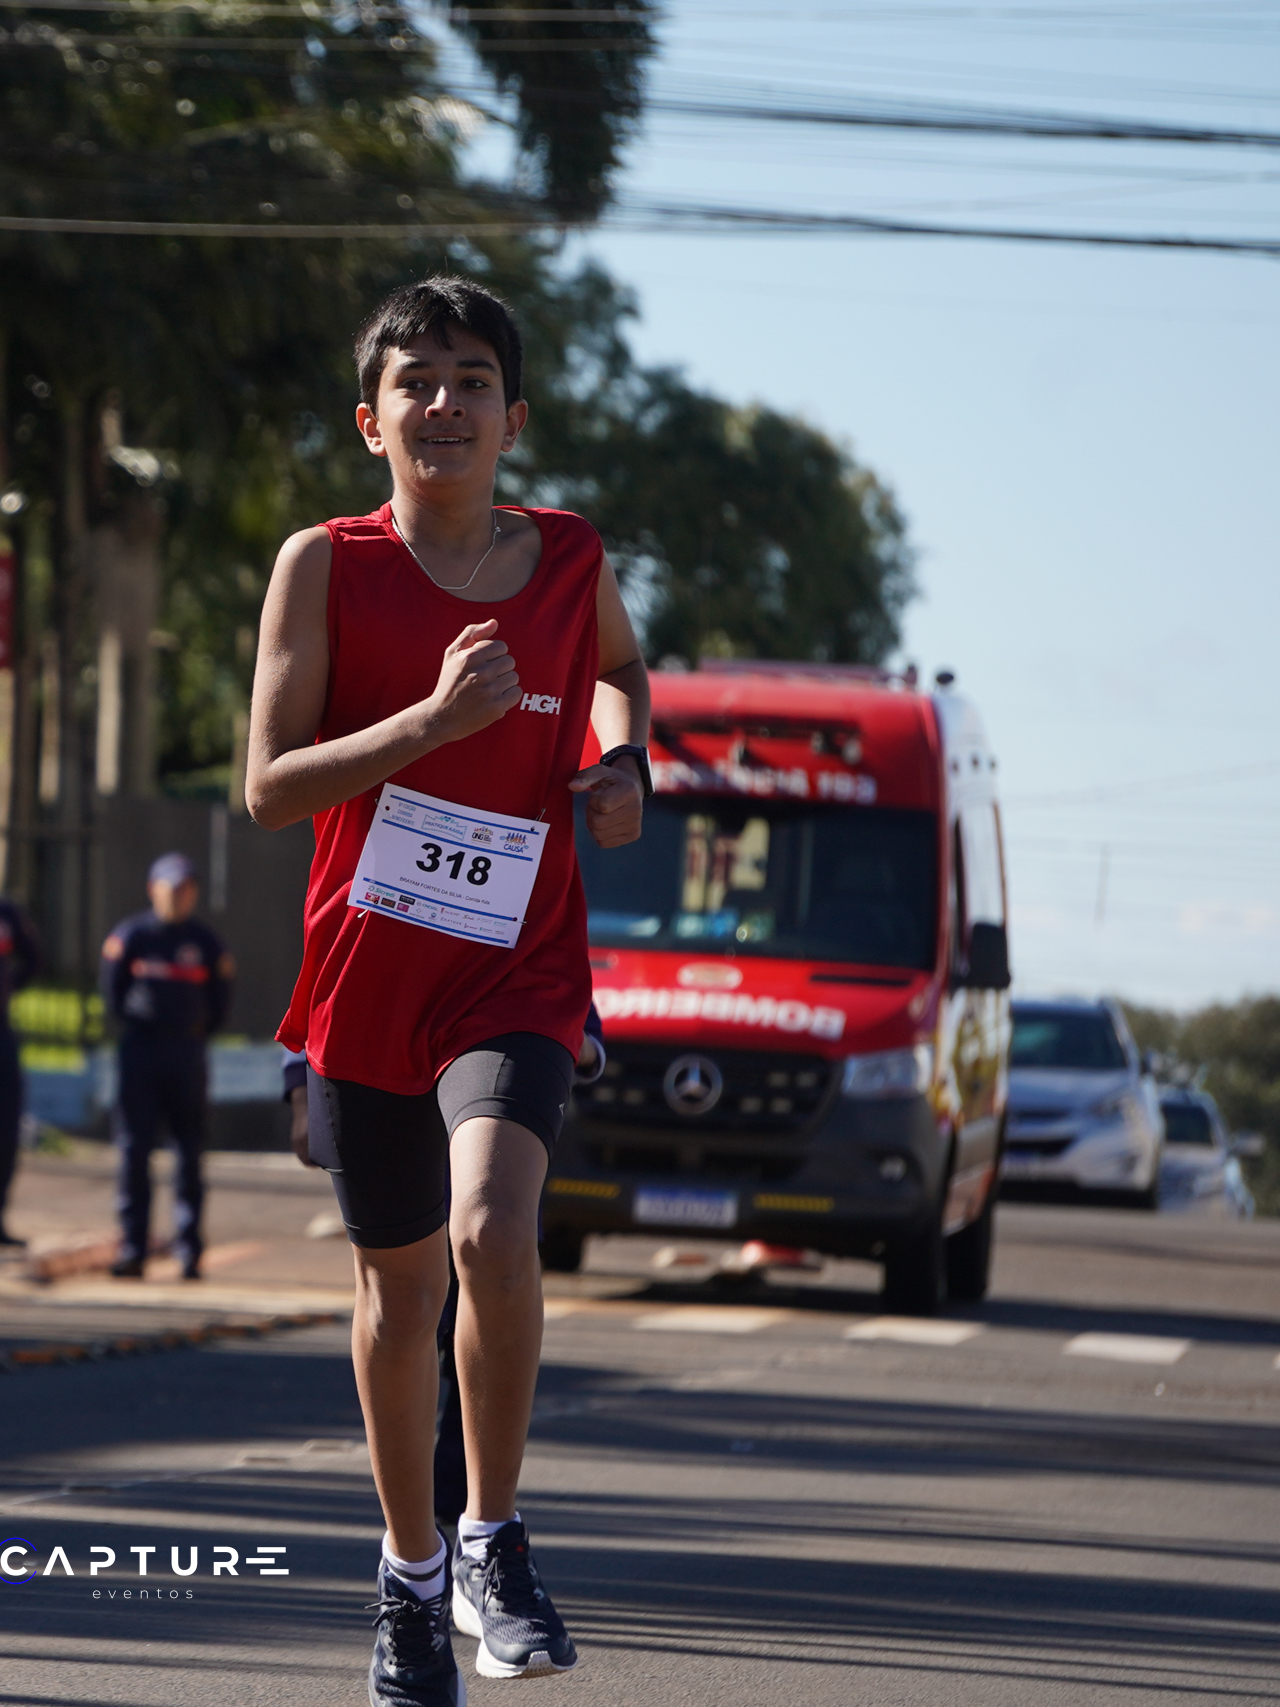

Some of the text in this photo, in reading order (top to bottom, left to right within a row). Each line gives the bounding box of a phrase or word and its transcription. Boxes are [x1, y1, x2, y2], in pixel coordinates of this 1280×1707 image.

[520, 693, 562, 715] HIGH
[425, 820, 448, 831] PRATIQUE
[503, 843, 524, 853] CAUSA
[416, 842, 492, 886] 318
[399, 876, 420, 887] BRAYAM
[420, 882, 440, 893] FORTES
[374, 887, 395, 898] Sicredi
